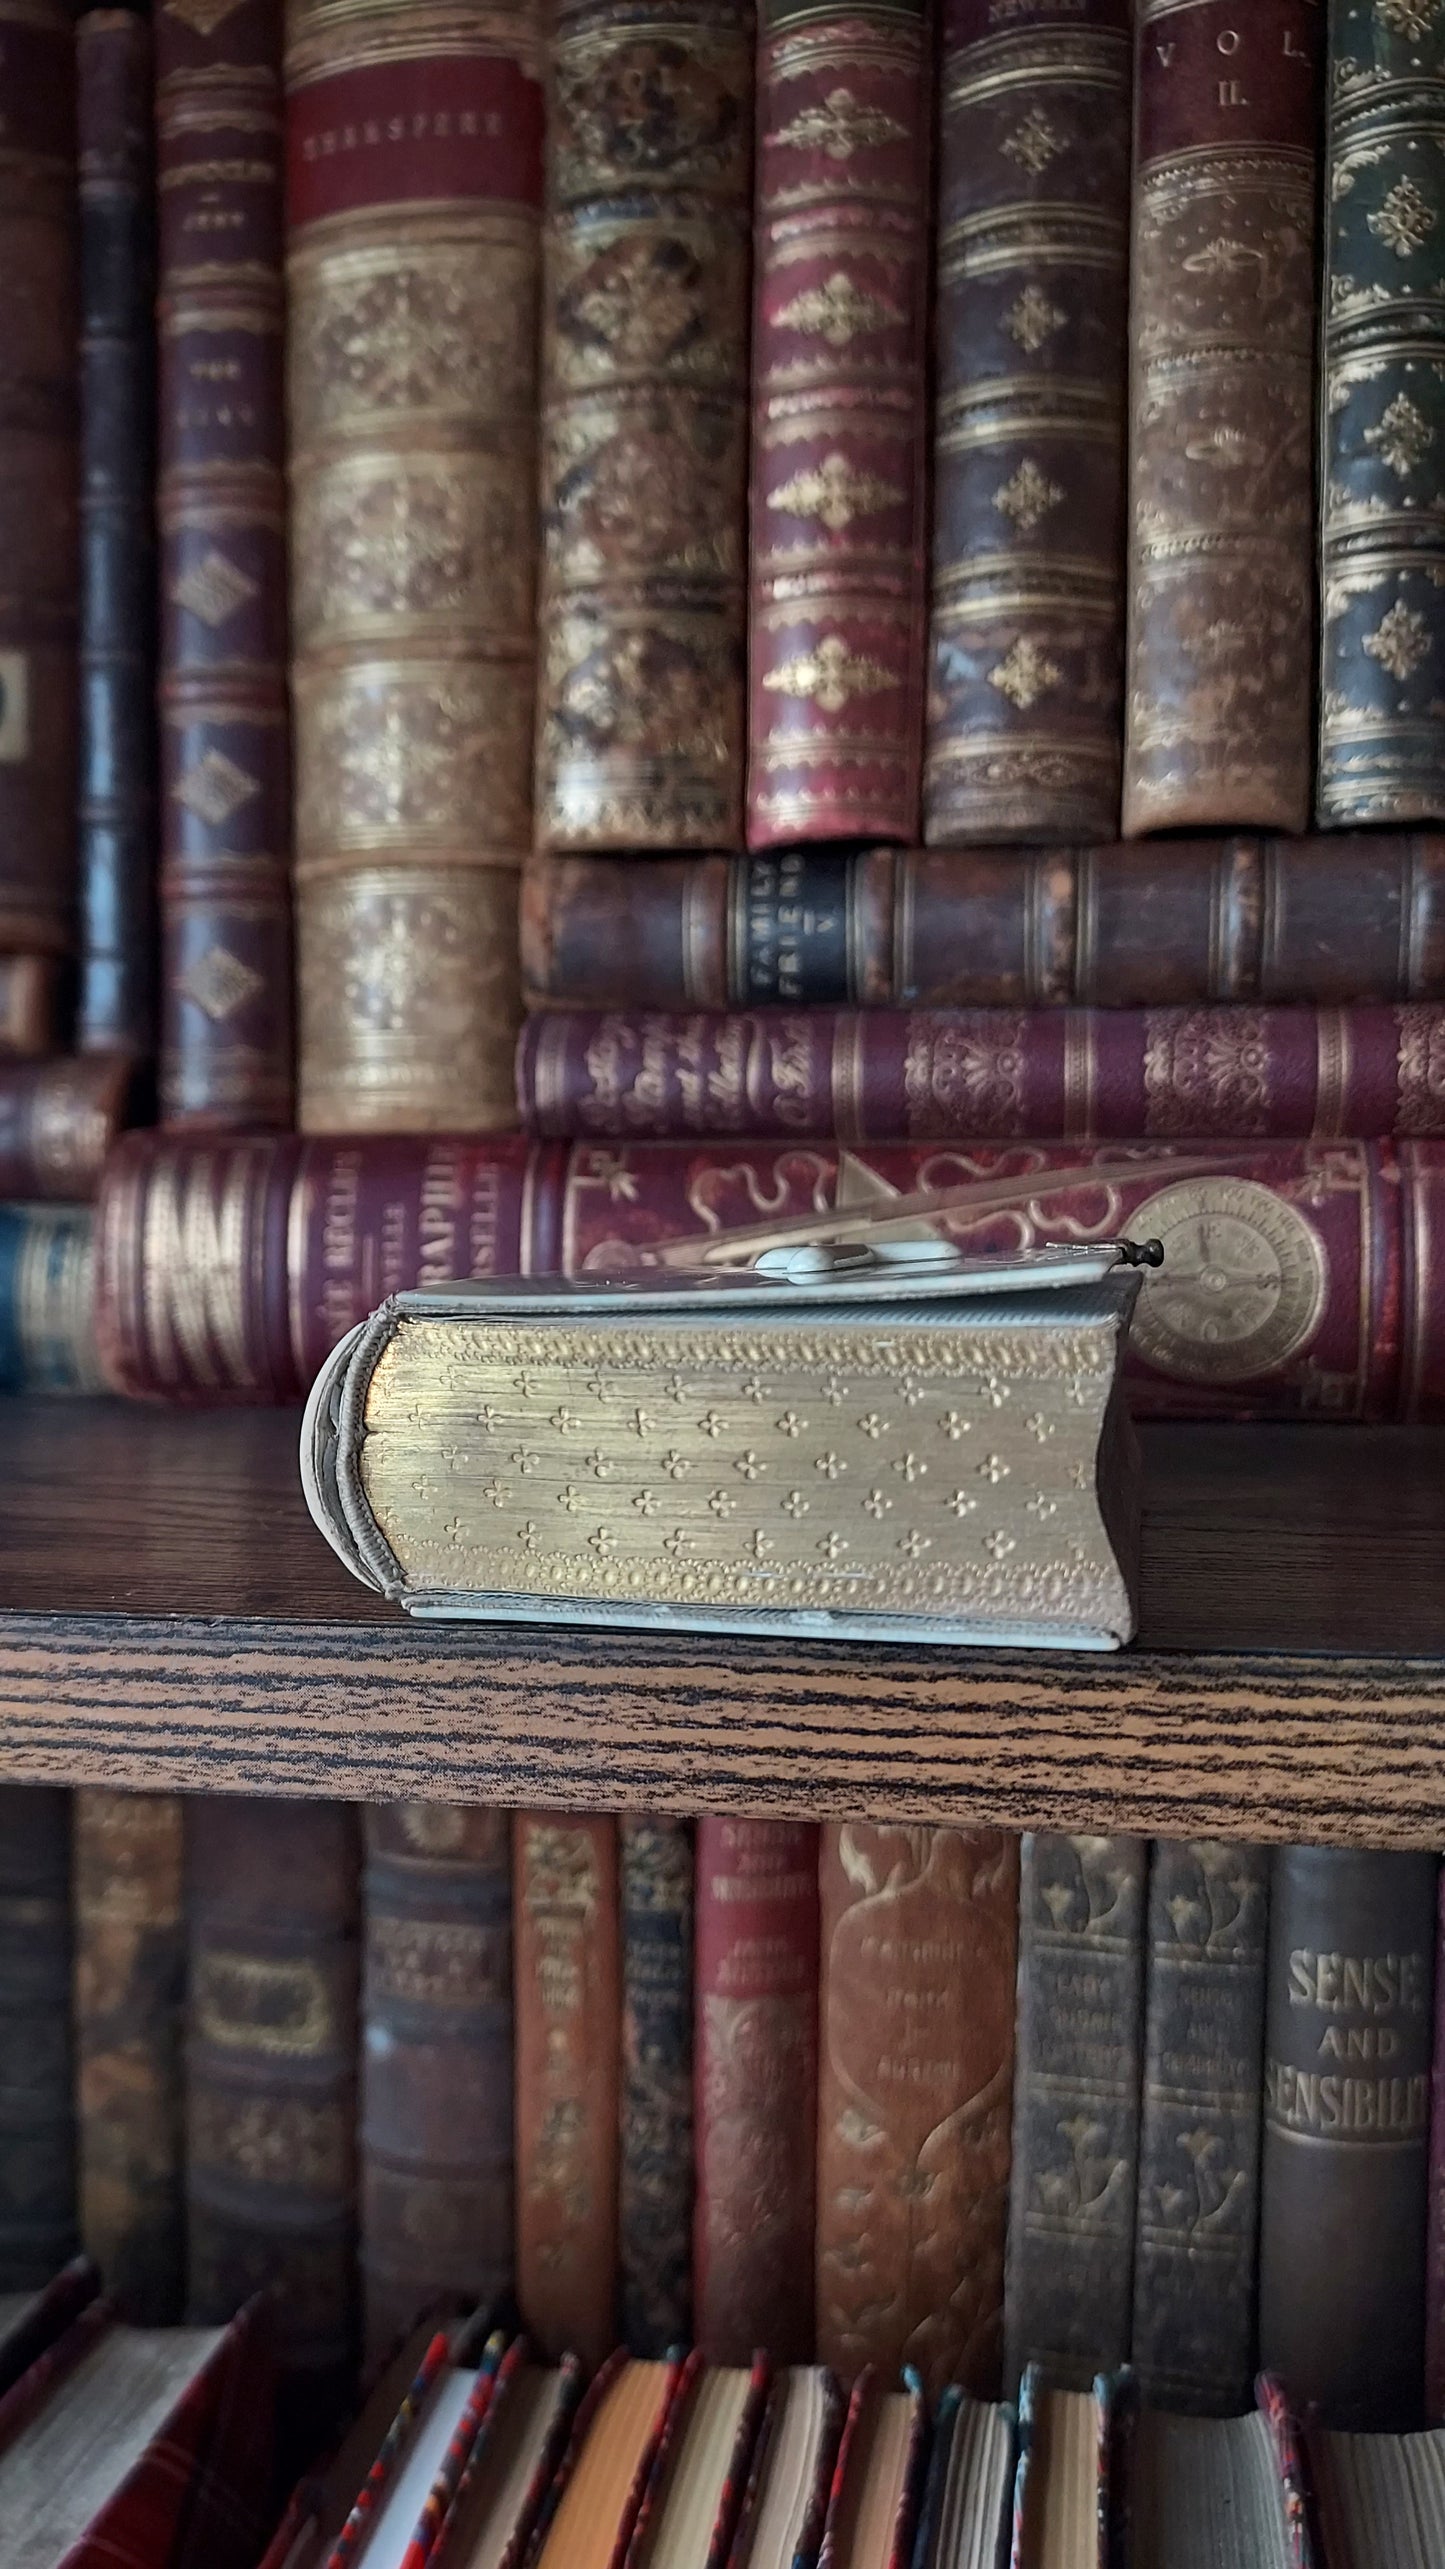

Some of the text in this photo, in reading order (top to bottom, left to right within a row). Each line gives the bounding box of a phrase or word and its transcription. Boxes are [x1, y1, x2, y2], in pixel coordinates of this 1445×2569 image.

[1217, 79, 1250, 107] II.
[751, 860, 775, 985] FAMILY
[778, 853, 803, 996] FRIEND
[381, 1202, 405, 1292] VELLE
[417, 1146, 457, 1287] RAPHIE
[1287, 1947, 1424, 2017] SENSE
[1317, 2026, 1400, 2060] AND
[1265, 2058, 1428, 2130] SENSIBILIT
